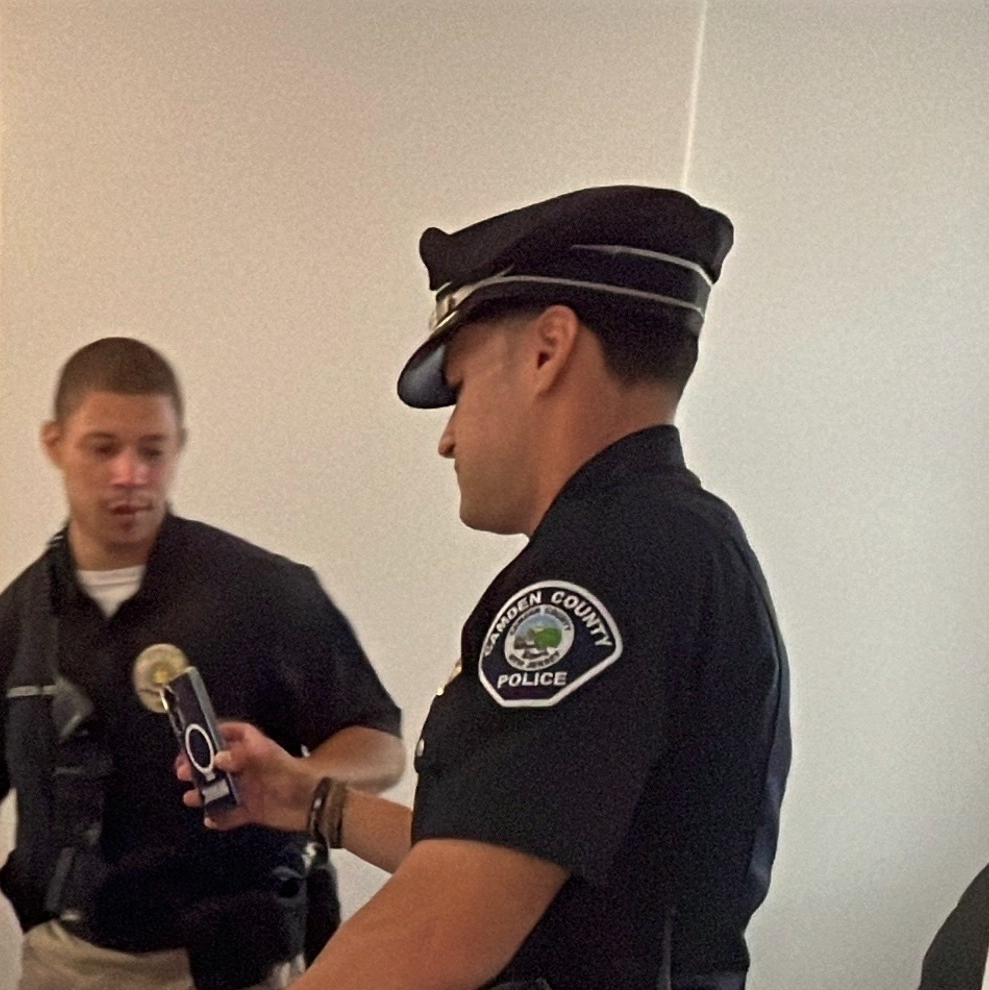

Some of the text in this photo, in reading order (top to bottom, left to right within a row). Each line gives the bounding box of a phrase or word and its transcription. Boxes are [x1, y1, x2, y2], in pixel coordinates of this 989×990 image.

[484, 591, 612, 656] CAMDEN COUNTY
[497, 671, 567, 689] POLICE
